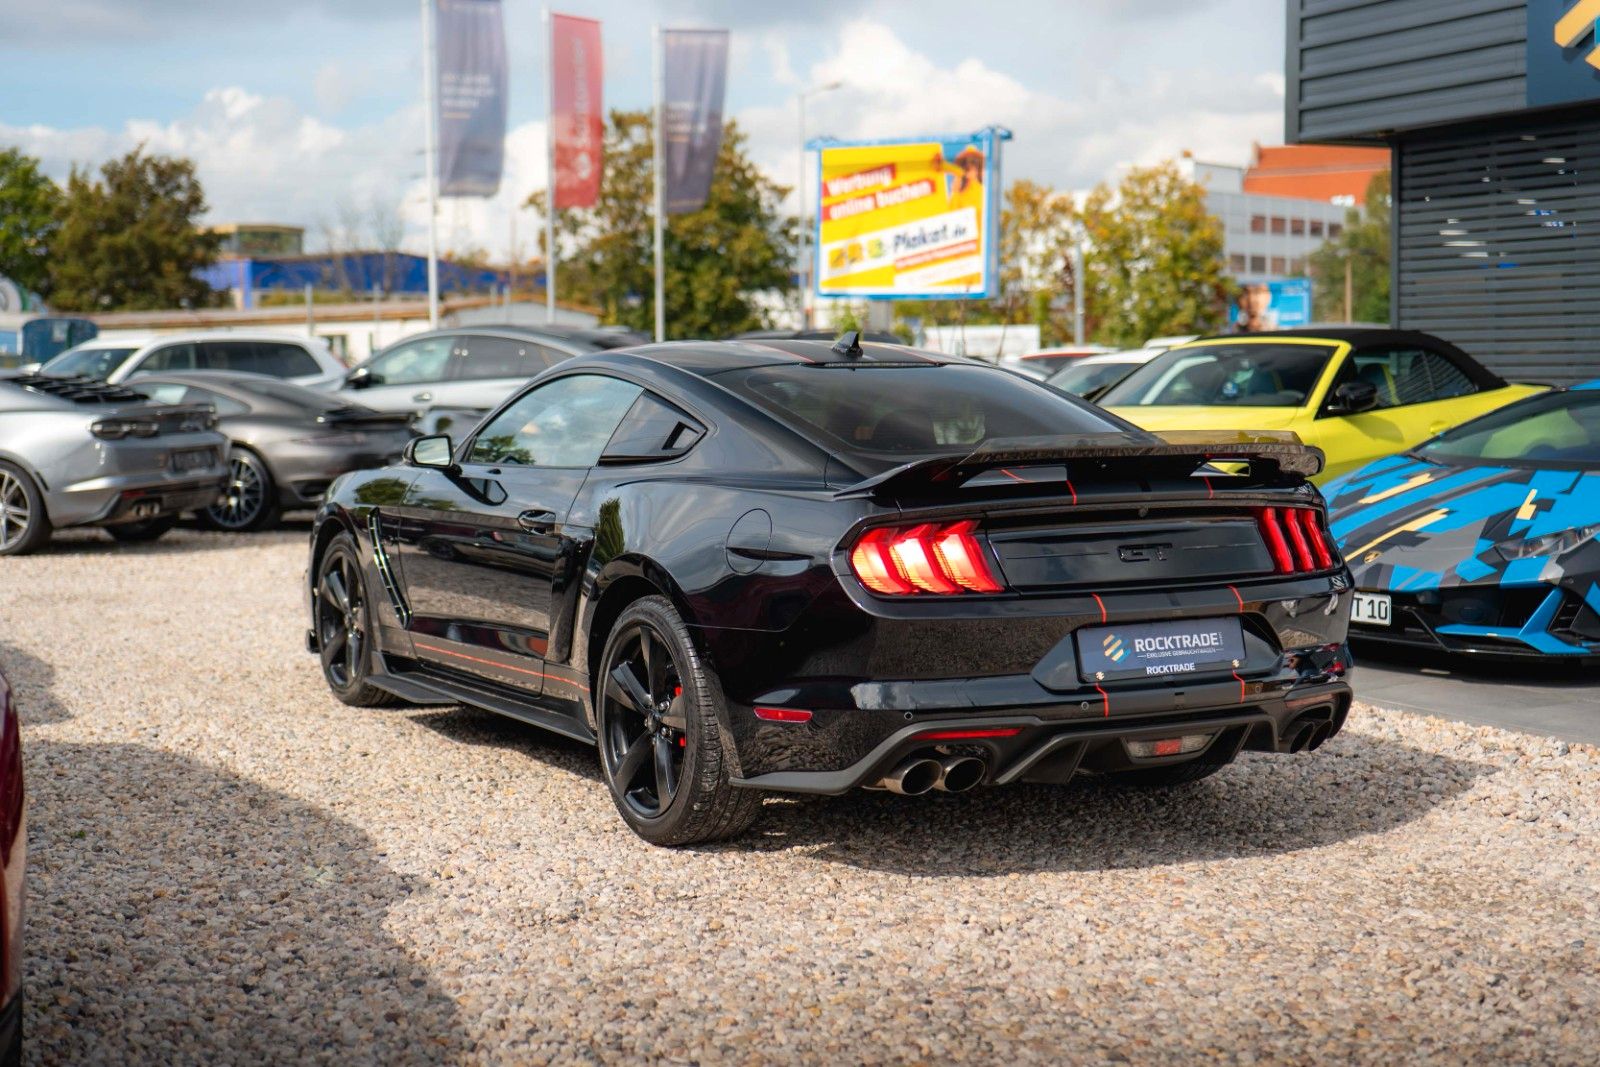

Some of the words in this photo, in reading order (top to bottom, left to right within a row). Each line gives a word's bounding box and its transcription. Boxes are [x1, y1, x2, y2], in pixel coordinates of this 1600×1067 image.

[827, 167, 892, 195] Werbung
[829, 196, 875, 219] online
[876, 180, 932, 208] buchen
[1117, 543, 1173, 562] GT
[1367, 599, 1388, 620] 10
[1135, 633, 1219, 652] ROCKTRADE
[1146, 651, 1172, 659] EXKLUSIVE
[1173, 648, 1216, 657] GEBRAUCHTWAGEN
[1146, 663, 1196, 675] ROCKTRADE
